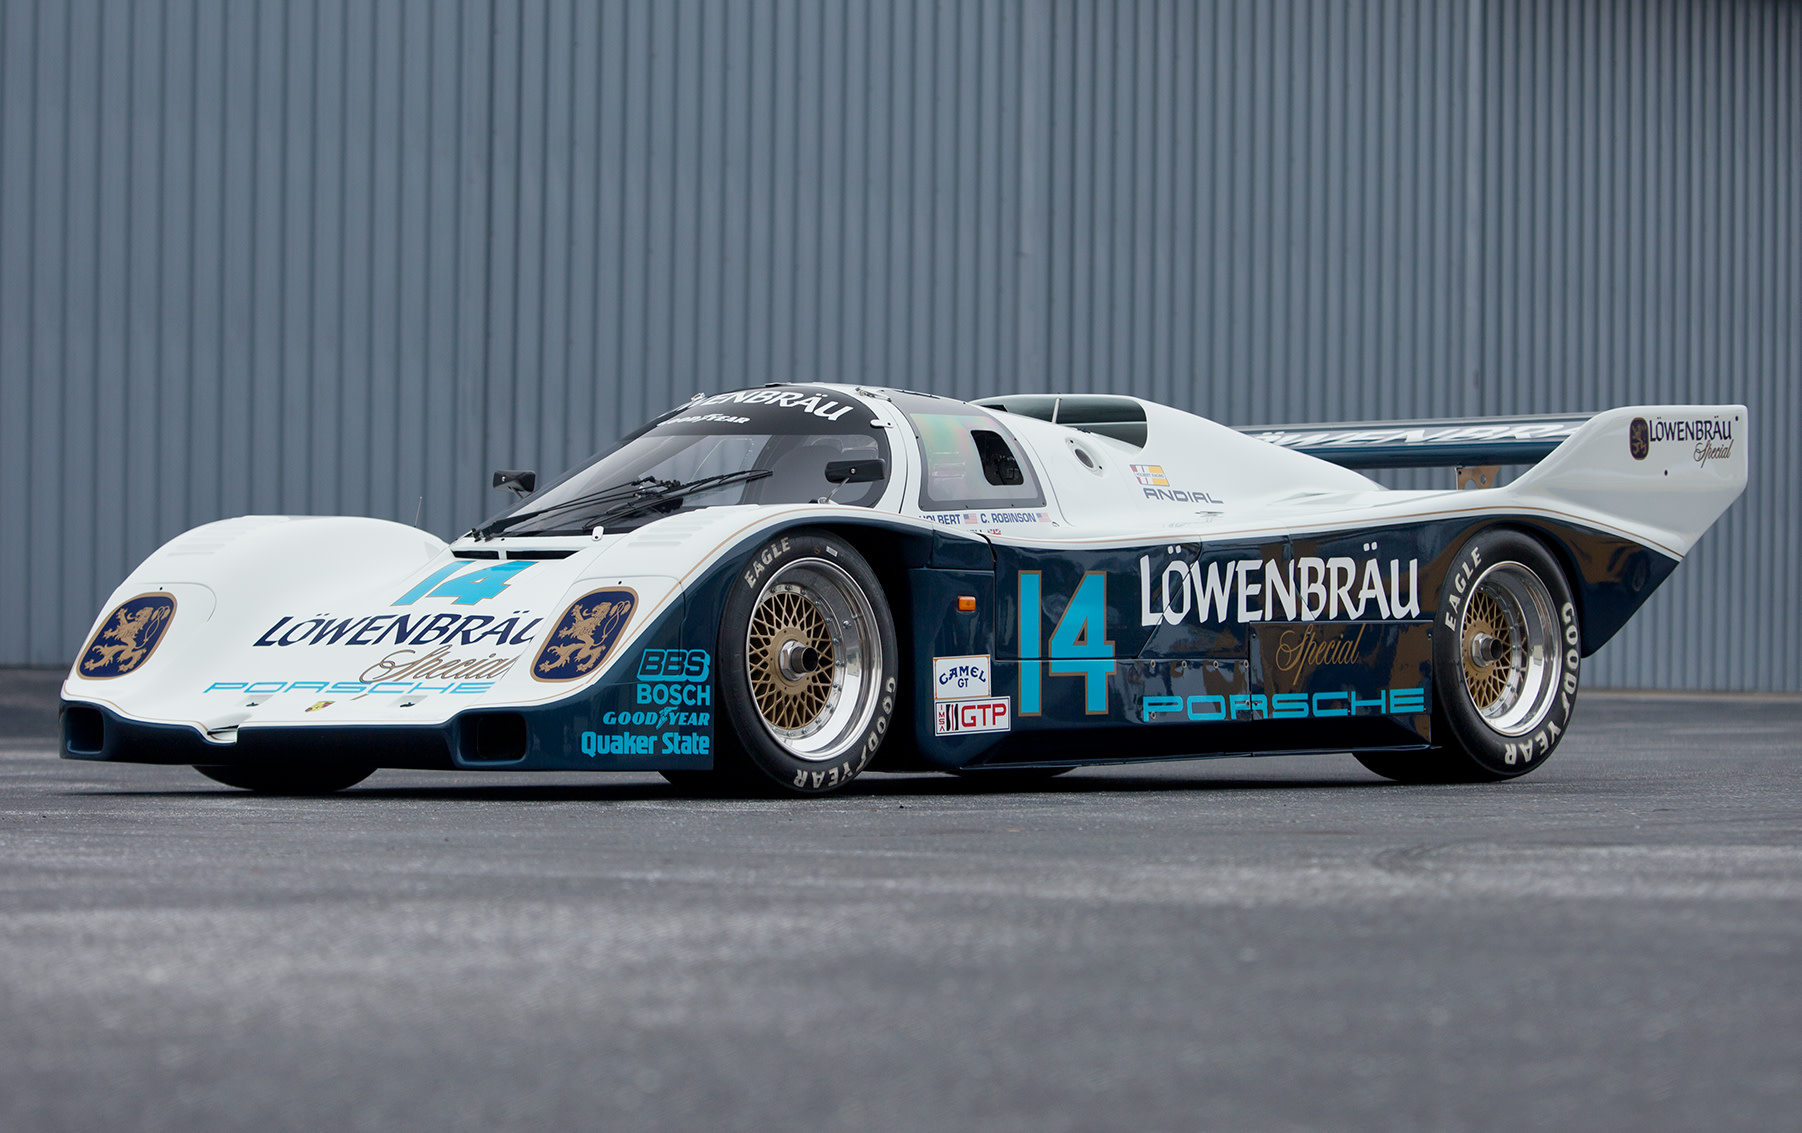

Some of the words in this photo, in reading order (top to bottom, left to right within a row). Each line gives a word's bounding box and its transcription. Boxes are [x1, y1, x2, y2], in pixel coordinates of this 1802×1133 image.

[1649, 415, 1732, 442] LÖWENBRÄU
[1693, 439, 1734, 469] Special
[1143, 487, 1224, 504] ANDIAL
[980, 513, 990, 524] C.
[992, 512, 1037, 523] ROBINSON
[744, 537, 791, 589] EAGLE
[390, 561, 539, 606] 14
[1140, 542, 1420, 627] LÖWENBRÄU
[1445, 547, 1482, 632] EAGLE
[1018, 570, 1115, 717] 14
[1276, 622, 1367, 686] Special
[637, 649, 711, 682] BBS
[939, 666, 987, 685] CAMEL
[203, 681, 497, 694] PORSCHE
[637, 684, 710, 706] BOSCH
[957, 678, 969, 688] GT
[1504, 602, 1579, 765] GOODYEAR
[603, 708, 710, 728] GOODYEAR
[961, 703, 1007, 728] GTP
[1143, 688, 1425, 722] PORSCHE
[581, 731, 658, 758] Quaker
[661, 731, 710, 755] State
[793, 677, 896, 789] GOODYEAR
